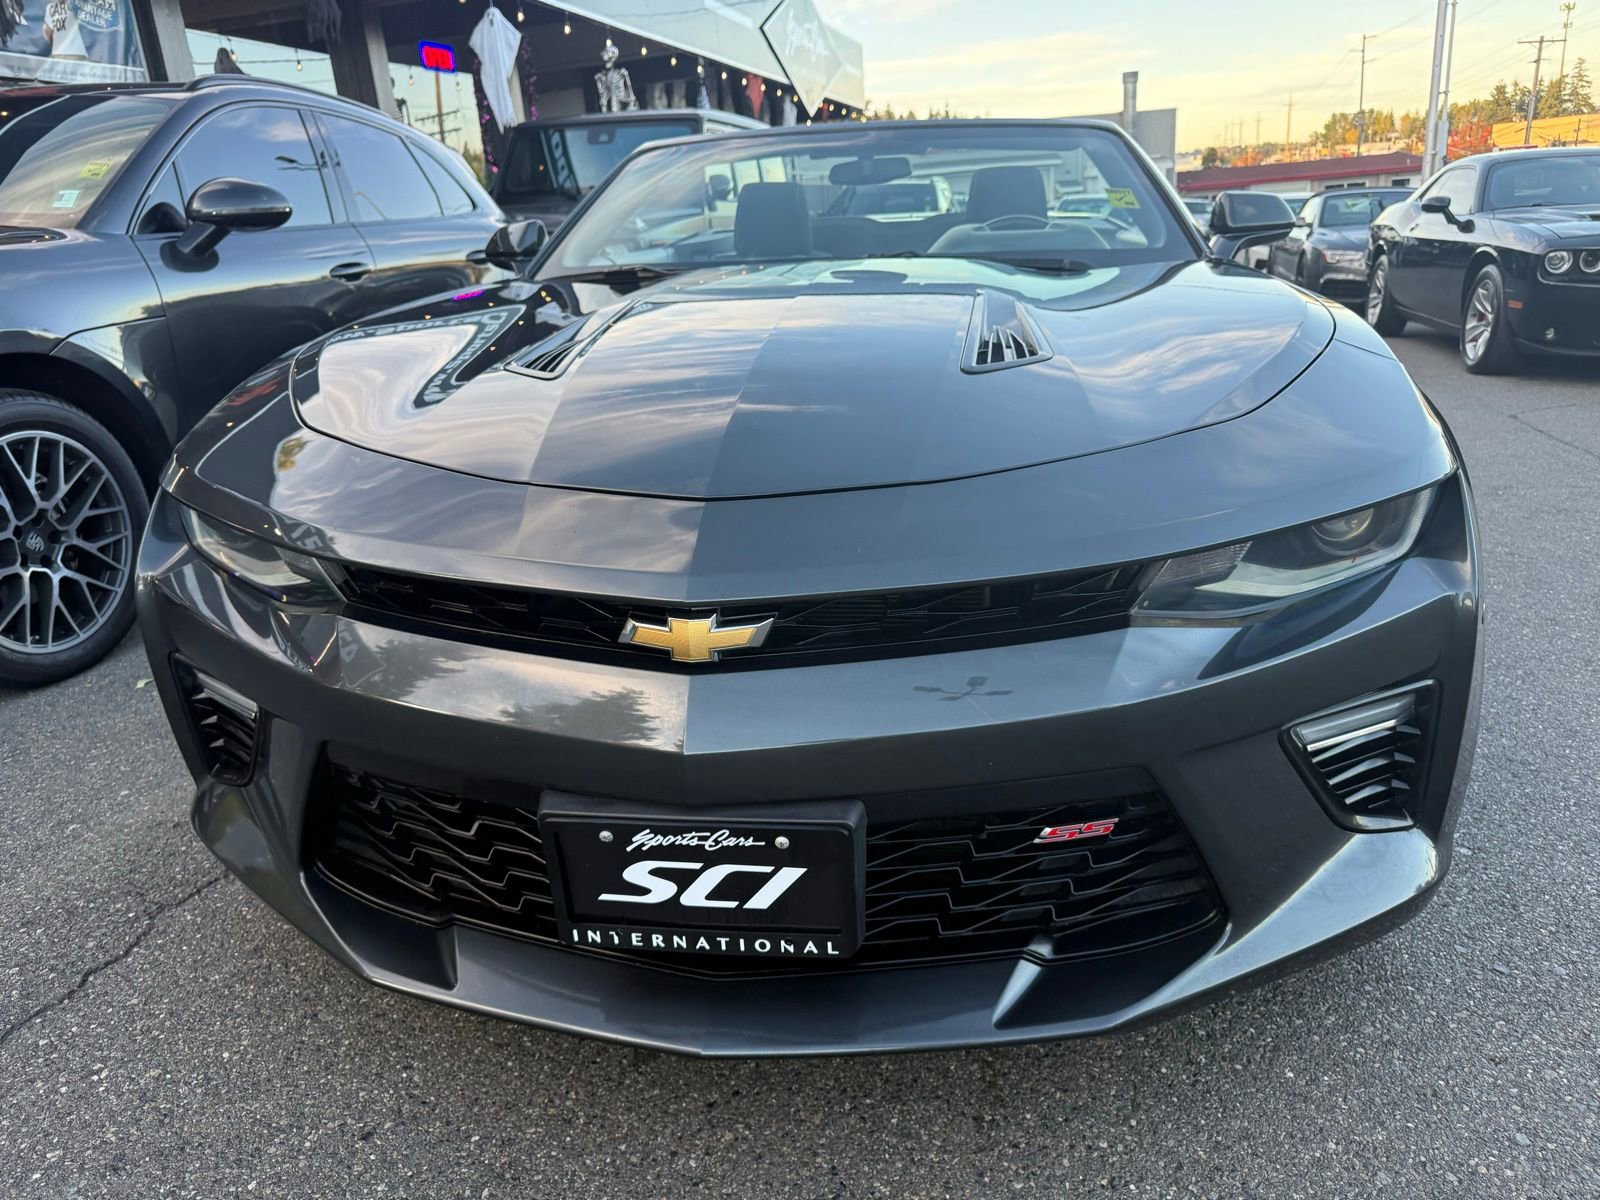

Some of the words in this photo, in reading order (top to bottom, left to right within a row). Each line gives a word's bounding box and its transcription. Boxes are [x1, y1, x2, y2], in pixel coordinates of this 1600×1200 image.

[48, 3, 69, 18] CAR
[626, 828, 711, 852] Sports
[704, 829, 766, 851] Cars
[1032, 817, 1120, 844] SS
[597, 860, 809, 910] SCI
[572, 928, 840, 955] INTERNATIONAL
